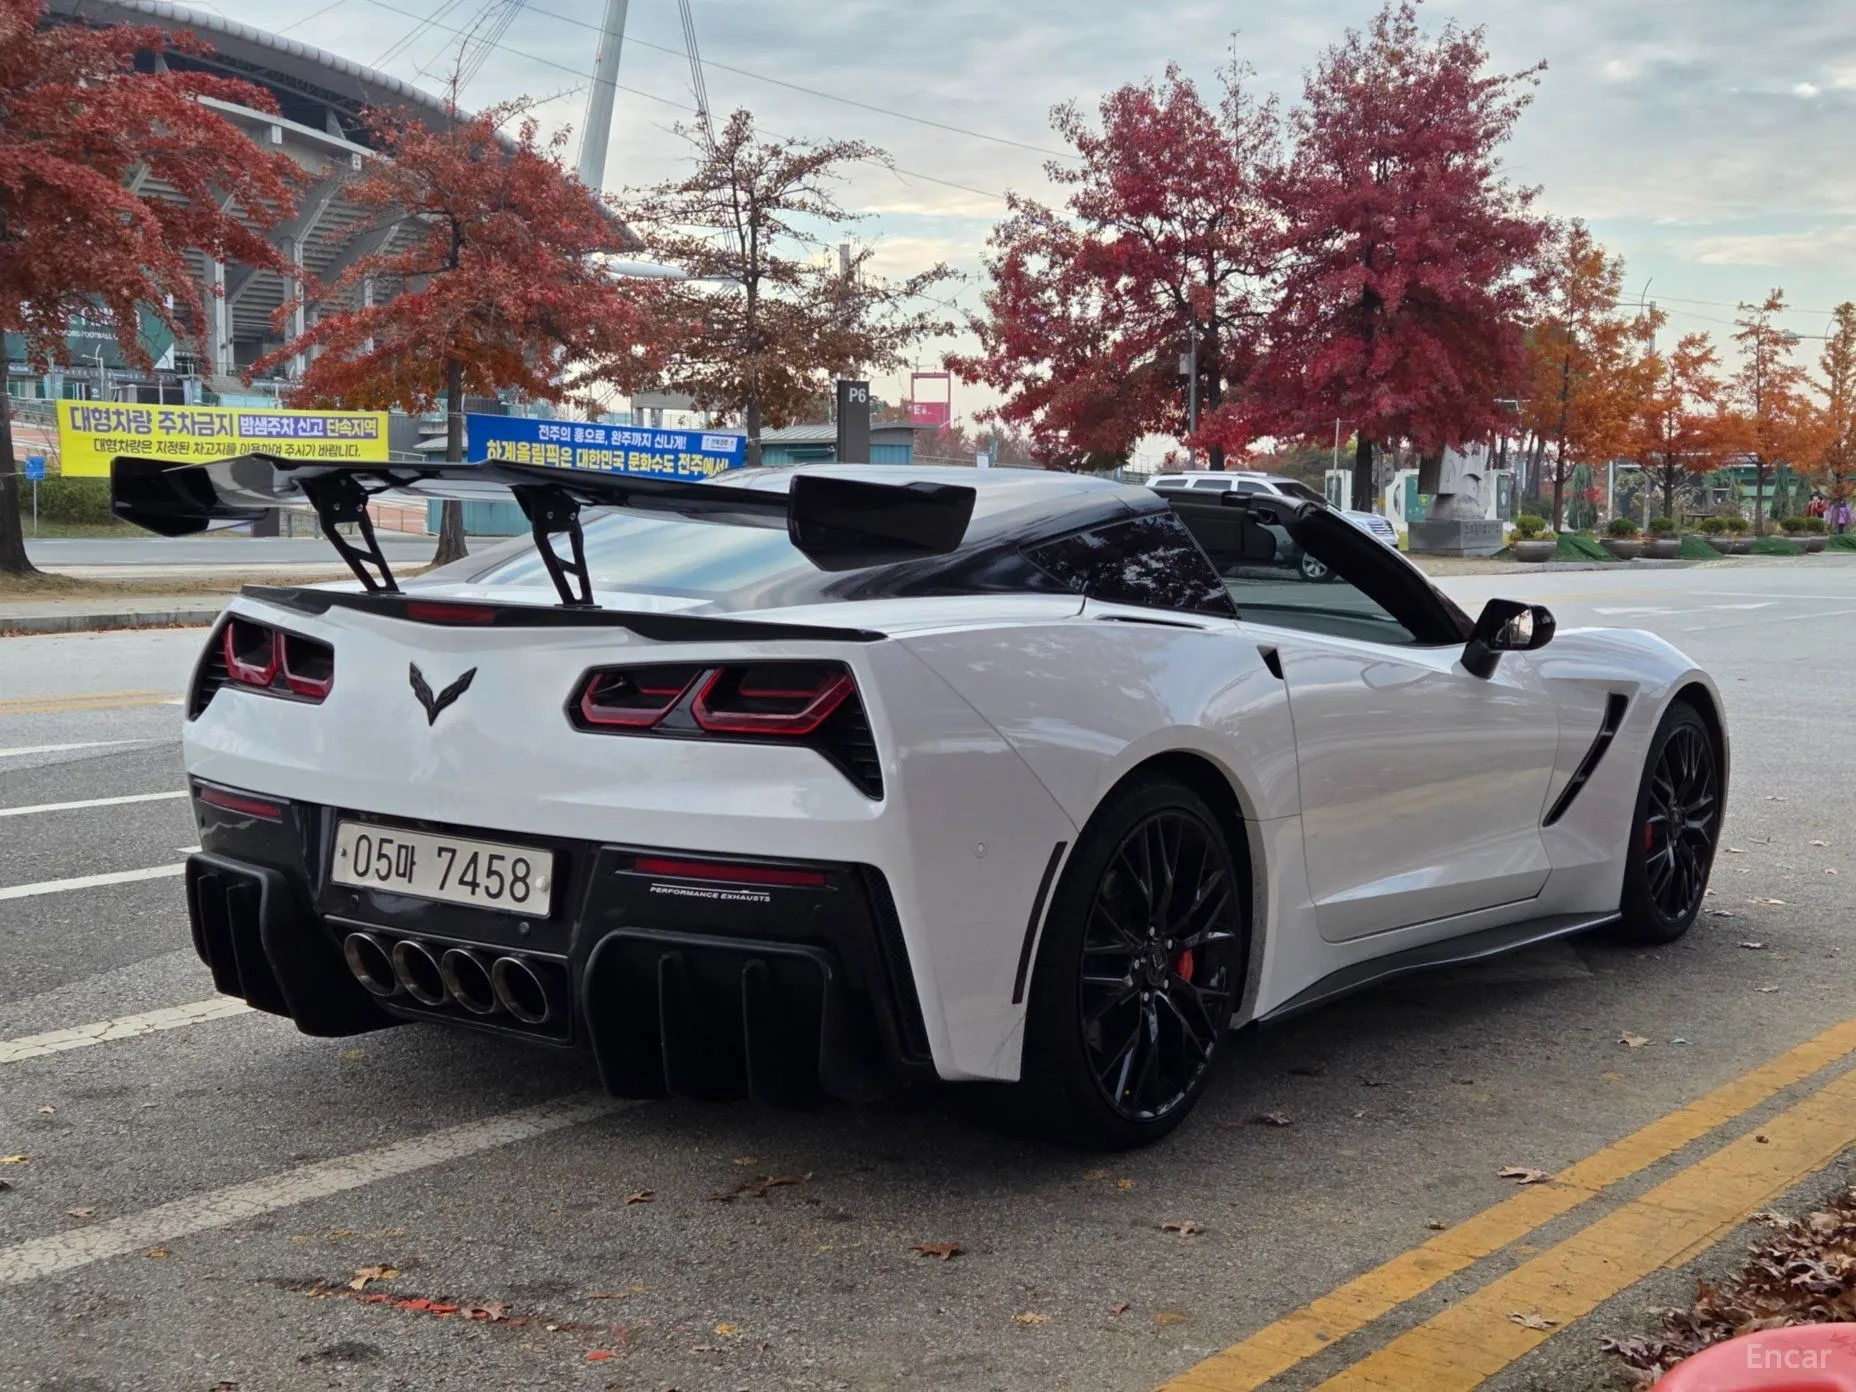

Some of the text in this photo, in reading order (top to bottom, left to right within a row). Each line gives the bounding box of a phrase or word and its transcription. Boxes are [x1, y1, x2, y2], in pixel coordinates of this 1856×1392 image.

[849, 387, 866, 402] P6
[70, 407, 377, 437] 대형차량 주차금지 밤샘주차 신고 단속지역
[93, 438, 153, 454] 대형차량은
[156, 440, 190, 455] 지정된
[285, 443, 316, 457] 주시기
[318, 444, 361, 457] 바랍니다.
[538, 424, 571, 441] 전주의
[611, 430, 652, 448] 완주까지
[654, 433, 687, 450] 신나게!
[486, 439, 573, 469] 하계올림픽은
[576, 448, 625, 471] 대한민국
[628, 451, 675, 473] 문화수도
[353, 834, 531, 903] 05마 7458
[650, 886, 771, 902] PERFORMANCE EXHAUSTS
